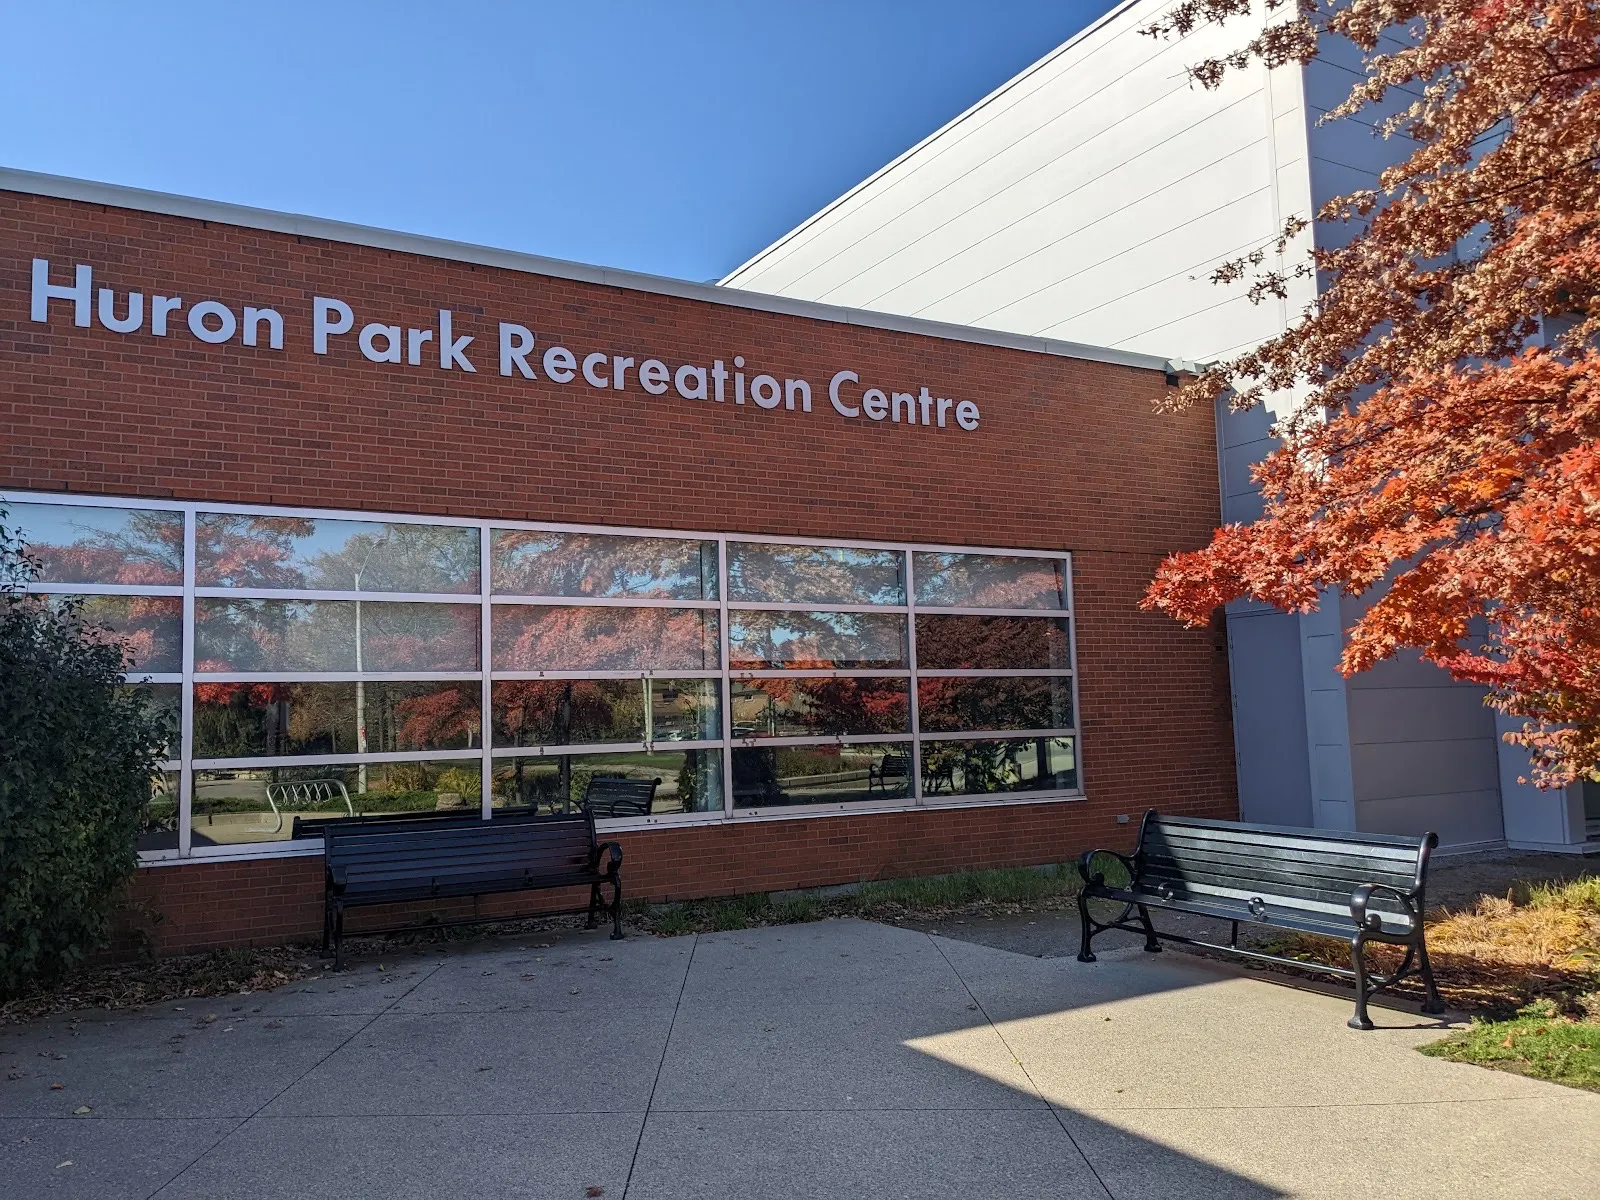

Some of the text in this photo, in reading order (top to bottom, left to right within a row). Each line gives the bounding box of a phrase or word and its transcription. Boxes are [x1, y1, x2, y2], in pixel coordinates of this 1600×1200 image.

[30, 257, 981, 432] Huron Park Recreation Centre
